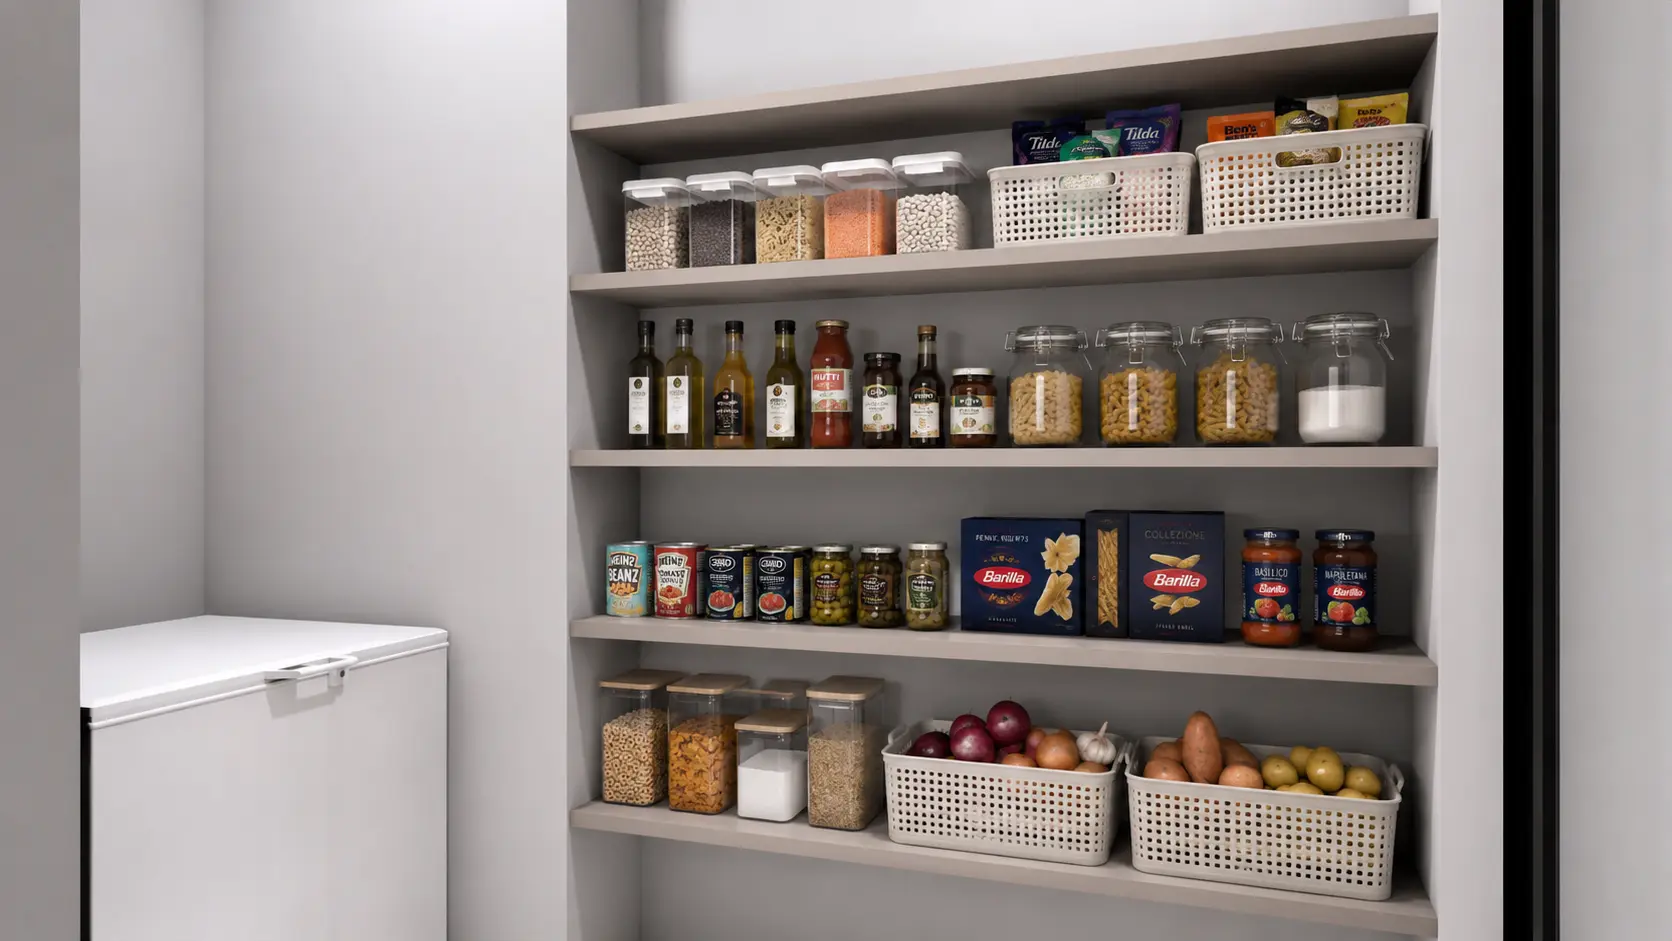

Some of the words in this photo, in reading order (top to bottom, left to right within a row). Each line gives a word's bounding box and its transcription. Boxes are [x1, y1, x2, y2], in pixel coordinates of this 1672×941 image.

[1124, 126, 1160, 141] Tilda
[1224, 124, 1257, 135] Ben's
[1144, 529, 1206, 541] COLLEZIONE
[608, 568, 639, 583] BEANZ
[983, 570, 1025, 584] Barilla
[1255, 567, 1288, 578] BASILICO
[1153, 573, 1200, 587] Barilla
